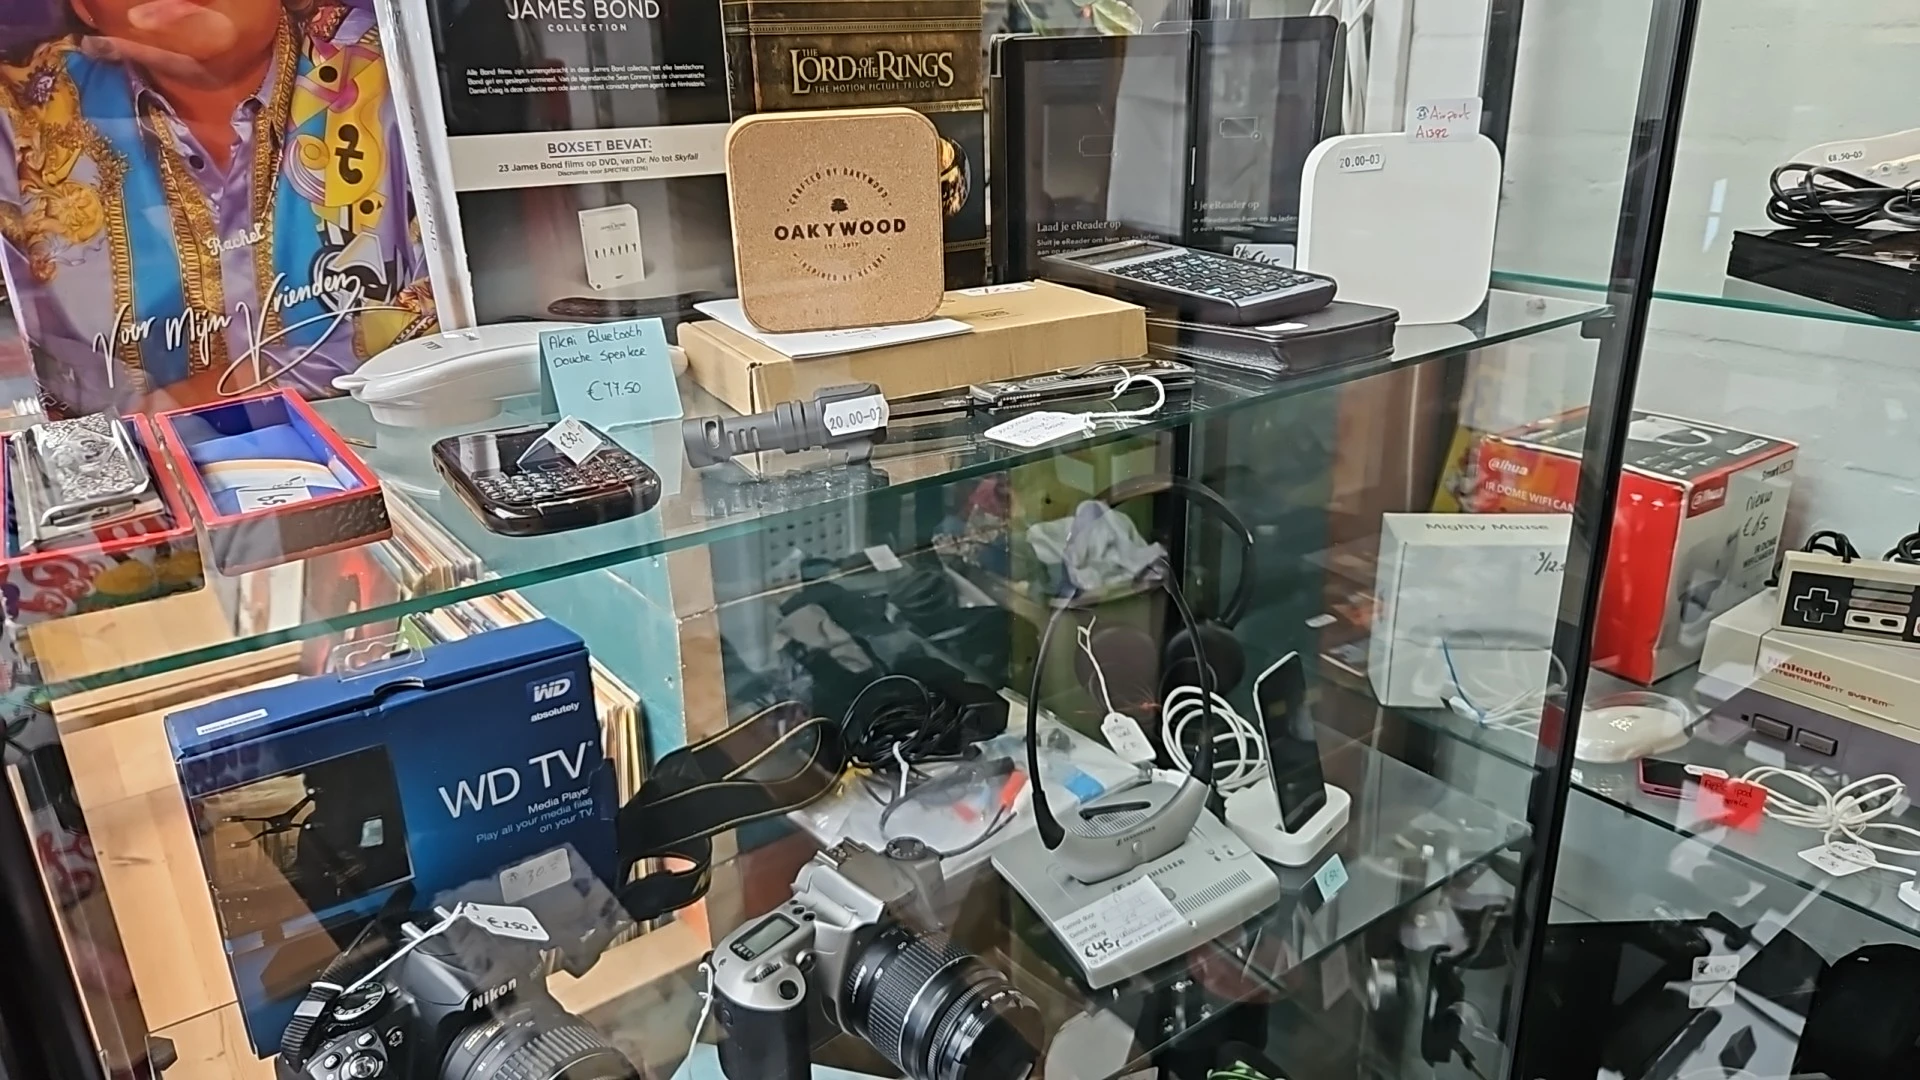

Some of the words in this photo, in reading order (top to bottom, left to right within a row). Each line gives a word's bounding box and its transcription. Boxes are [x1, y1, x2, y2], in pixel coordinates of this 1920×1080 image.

[508, 0, 586, 19] JAMES
[594, 0, 660, 19] BOND
[548, 24, 627, 32] COLLECTION
[802, 49, 818, 57] THE
[859, 58, 874, 67] OF
[790, 50, 857, 94] LORD
[857, 66, 878, 78] THE
[877, 51, 954, 87] RINGS
[833, 84, 865, 92] MOTION
[869, 82, 899, 91] PICTURE
[548, 140, 601, 154] BOXSET
[607, 138, 652, 150] BEVAT:
[499, 164, 509, 172] 23
[512, 163, 538, 172] James
[541, 161, 562, 170] Bond
[565, 159, 584, 168] films
[586, 160, 597, 170] op
[599, 158, 619, 167] DVD,
[636, 155, 647, 164] Dr.
[650, 155, 660, 163] No
[662, 154, 672, 162] tot
[674, 153, 698, 163] Skyfall
[789, 172, 820, 205] CRAFTED
[826, 168, 837, 176] BY
[844, 167, 887, 198] OAKYWOOD
[1210, 201, 1246, 210] eReader
[774, 219, 906, 240] OAKYWOOD
[1037, 222, 1058, 232] Laad
[1060, 222, 1069, 233] je
[1071, 220, 1107, 230] eReader
[1110, 221, 1121, 230] op
[93, 303, 156, 388] Voor
[166, 308, 231, 366] Mijn
[218, 272, 372, 396] Vrienden
[1486, 481, 1495, 491] IR
[1497, 483, 1528, 500] DOME
[1529, 493, 1551, 506] WIFI
[1768, 656, 1831, 682] Nintendo
[534, 678, 571, 703] WD
[1769, 668, 1843, 693] NTERTAINMENT
[1848, 691, 1888, 707] SYSTEM
[530, 702, 580, 722] absolutely
[438, 767, 521, 819] WD
[528, 741, 588, 788] TV
[528, 796, 559, 815] Media
[476, 831, 499, 843] Play
[501, 824, 513, 835] all
[516, 816, 538, 832] your
[540, 805, 571, 820] media
[539, 824, 552, 833] on
[555, 815, 576, 829] your
[579, 808, 594, 819] TV.
[472, 978, 517, 1012] Nikon
